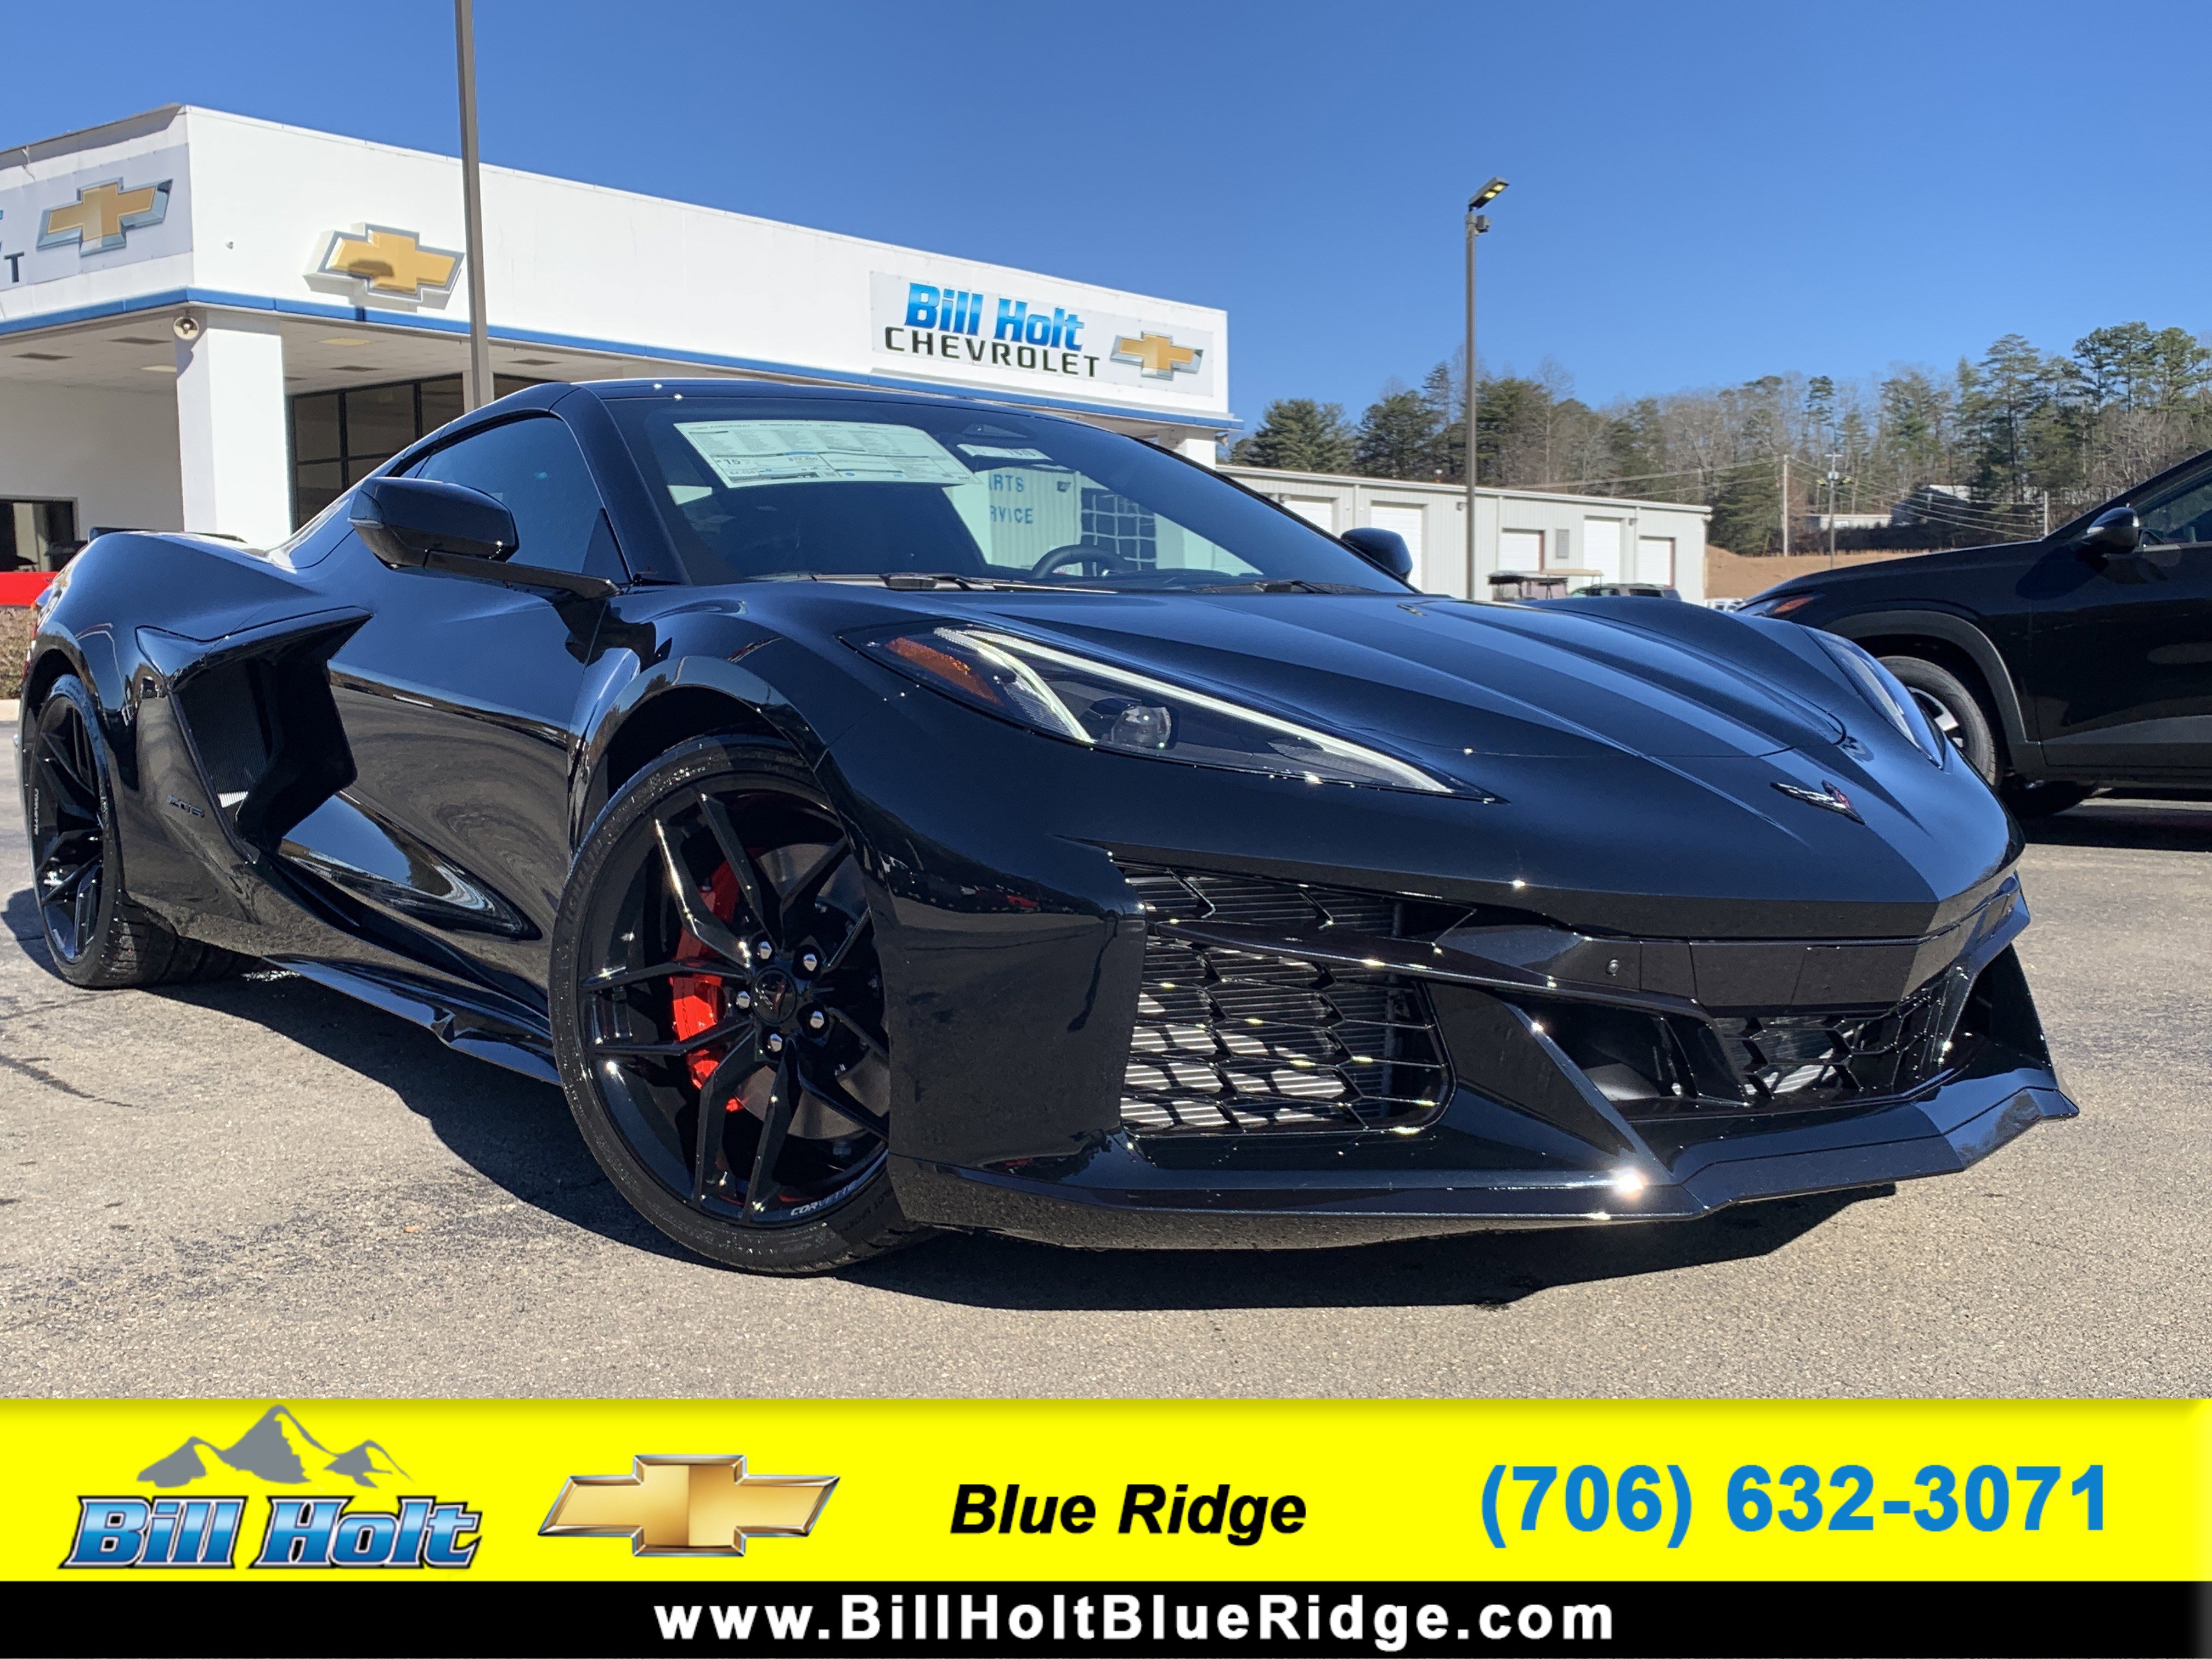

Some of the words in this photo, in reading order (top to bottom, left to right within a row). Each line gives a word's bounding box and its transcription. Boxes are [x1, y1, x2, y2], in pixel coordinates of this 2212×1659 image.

[904, 283, 984, 336] Bill
[994, 298, 1085, 351] Holt
[884, 326, 1100, 377] CHEVROLET
